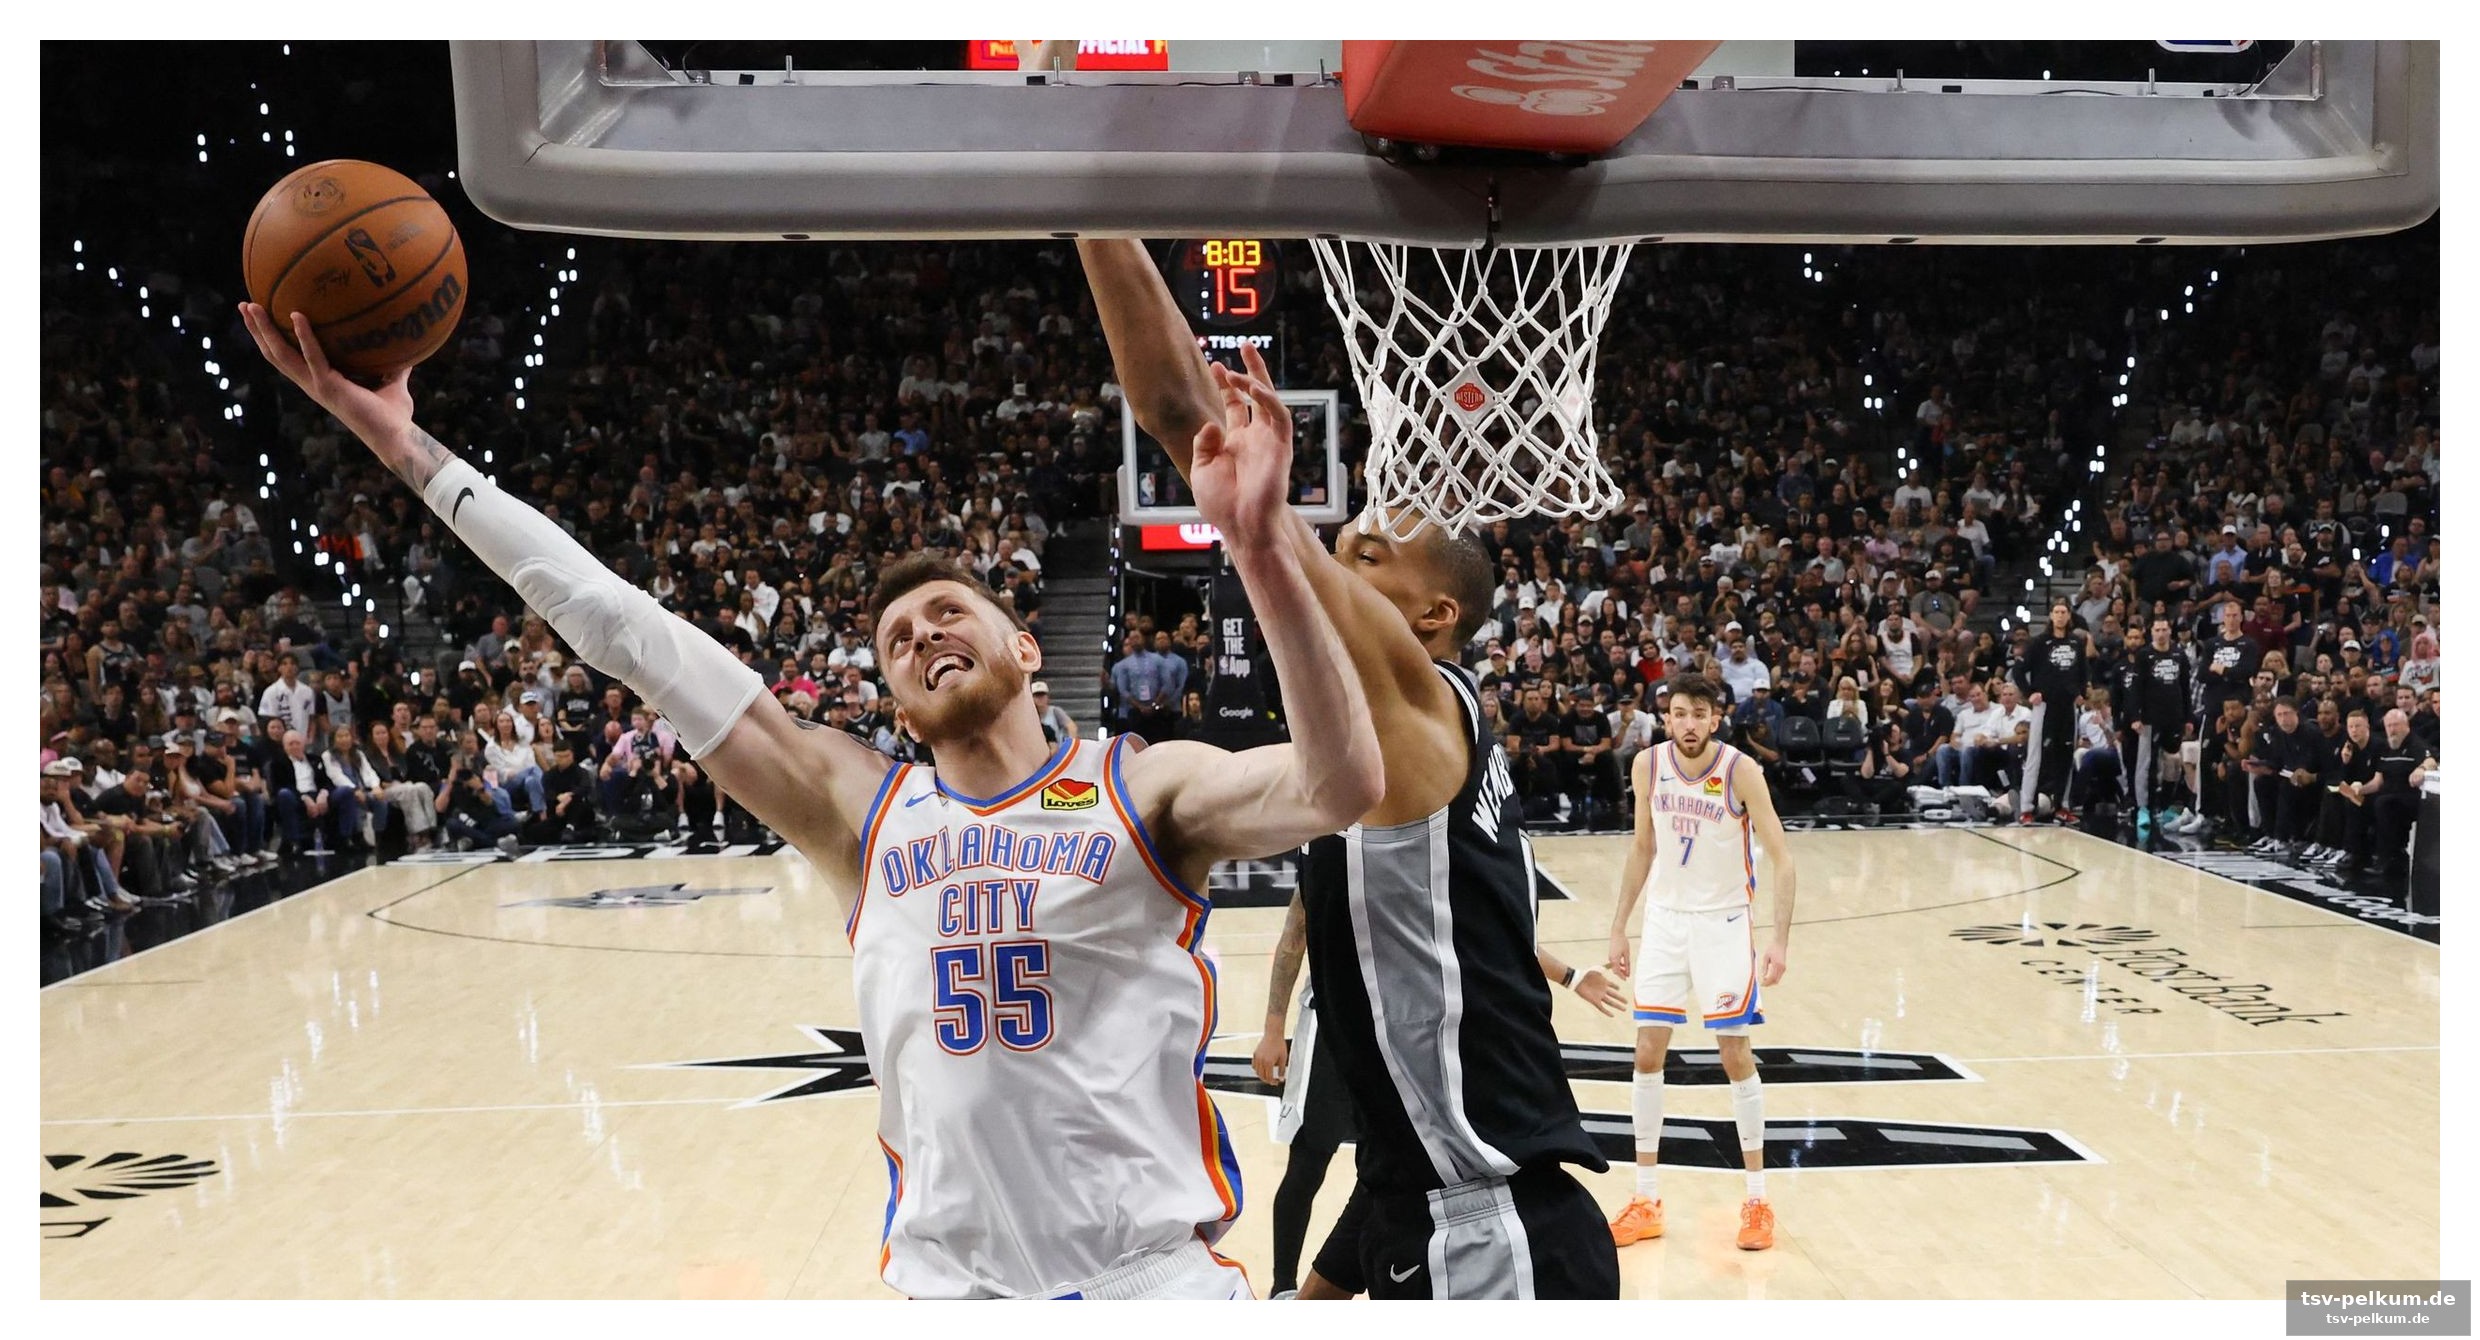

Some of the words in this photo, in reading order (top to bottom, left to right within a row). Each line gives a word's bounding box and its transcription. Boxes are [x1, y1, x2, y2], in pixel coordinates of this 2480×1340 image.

[1206, 240, 1261, 267] 8:03
[1216, 268, 1257, 315] 15
[1207, 335, 1273, 350] TISSOT
[1222, 618, 1244, 637] GET
[1223, 637, 1245, 655] THE
[1229, 656, 1251, 678] App
[1219, 706, 1254, 719] Google
[1472, 743, 1514, 844] WEMB
[1654, 793, 1725, 825] OKLAHOMA
[1672, 815, 1701, 836] CITY
[881, 823, 1116, 898] OKLAHOMA
[1680, 836, 1695, 868] 7
[938, 878, 1039, 938] CITY
[930, 939, 1055, 1056] 55
[2020, 959, 2164, 1014] CENTER
[2087, 947, 2233, 982] Frost
[2168, 983, 2352, 1027] Bank
